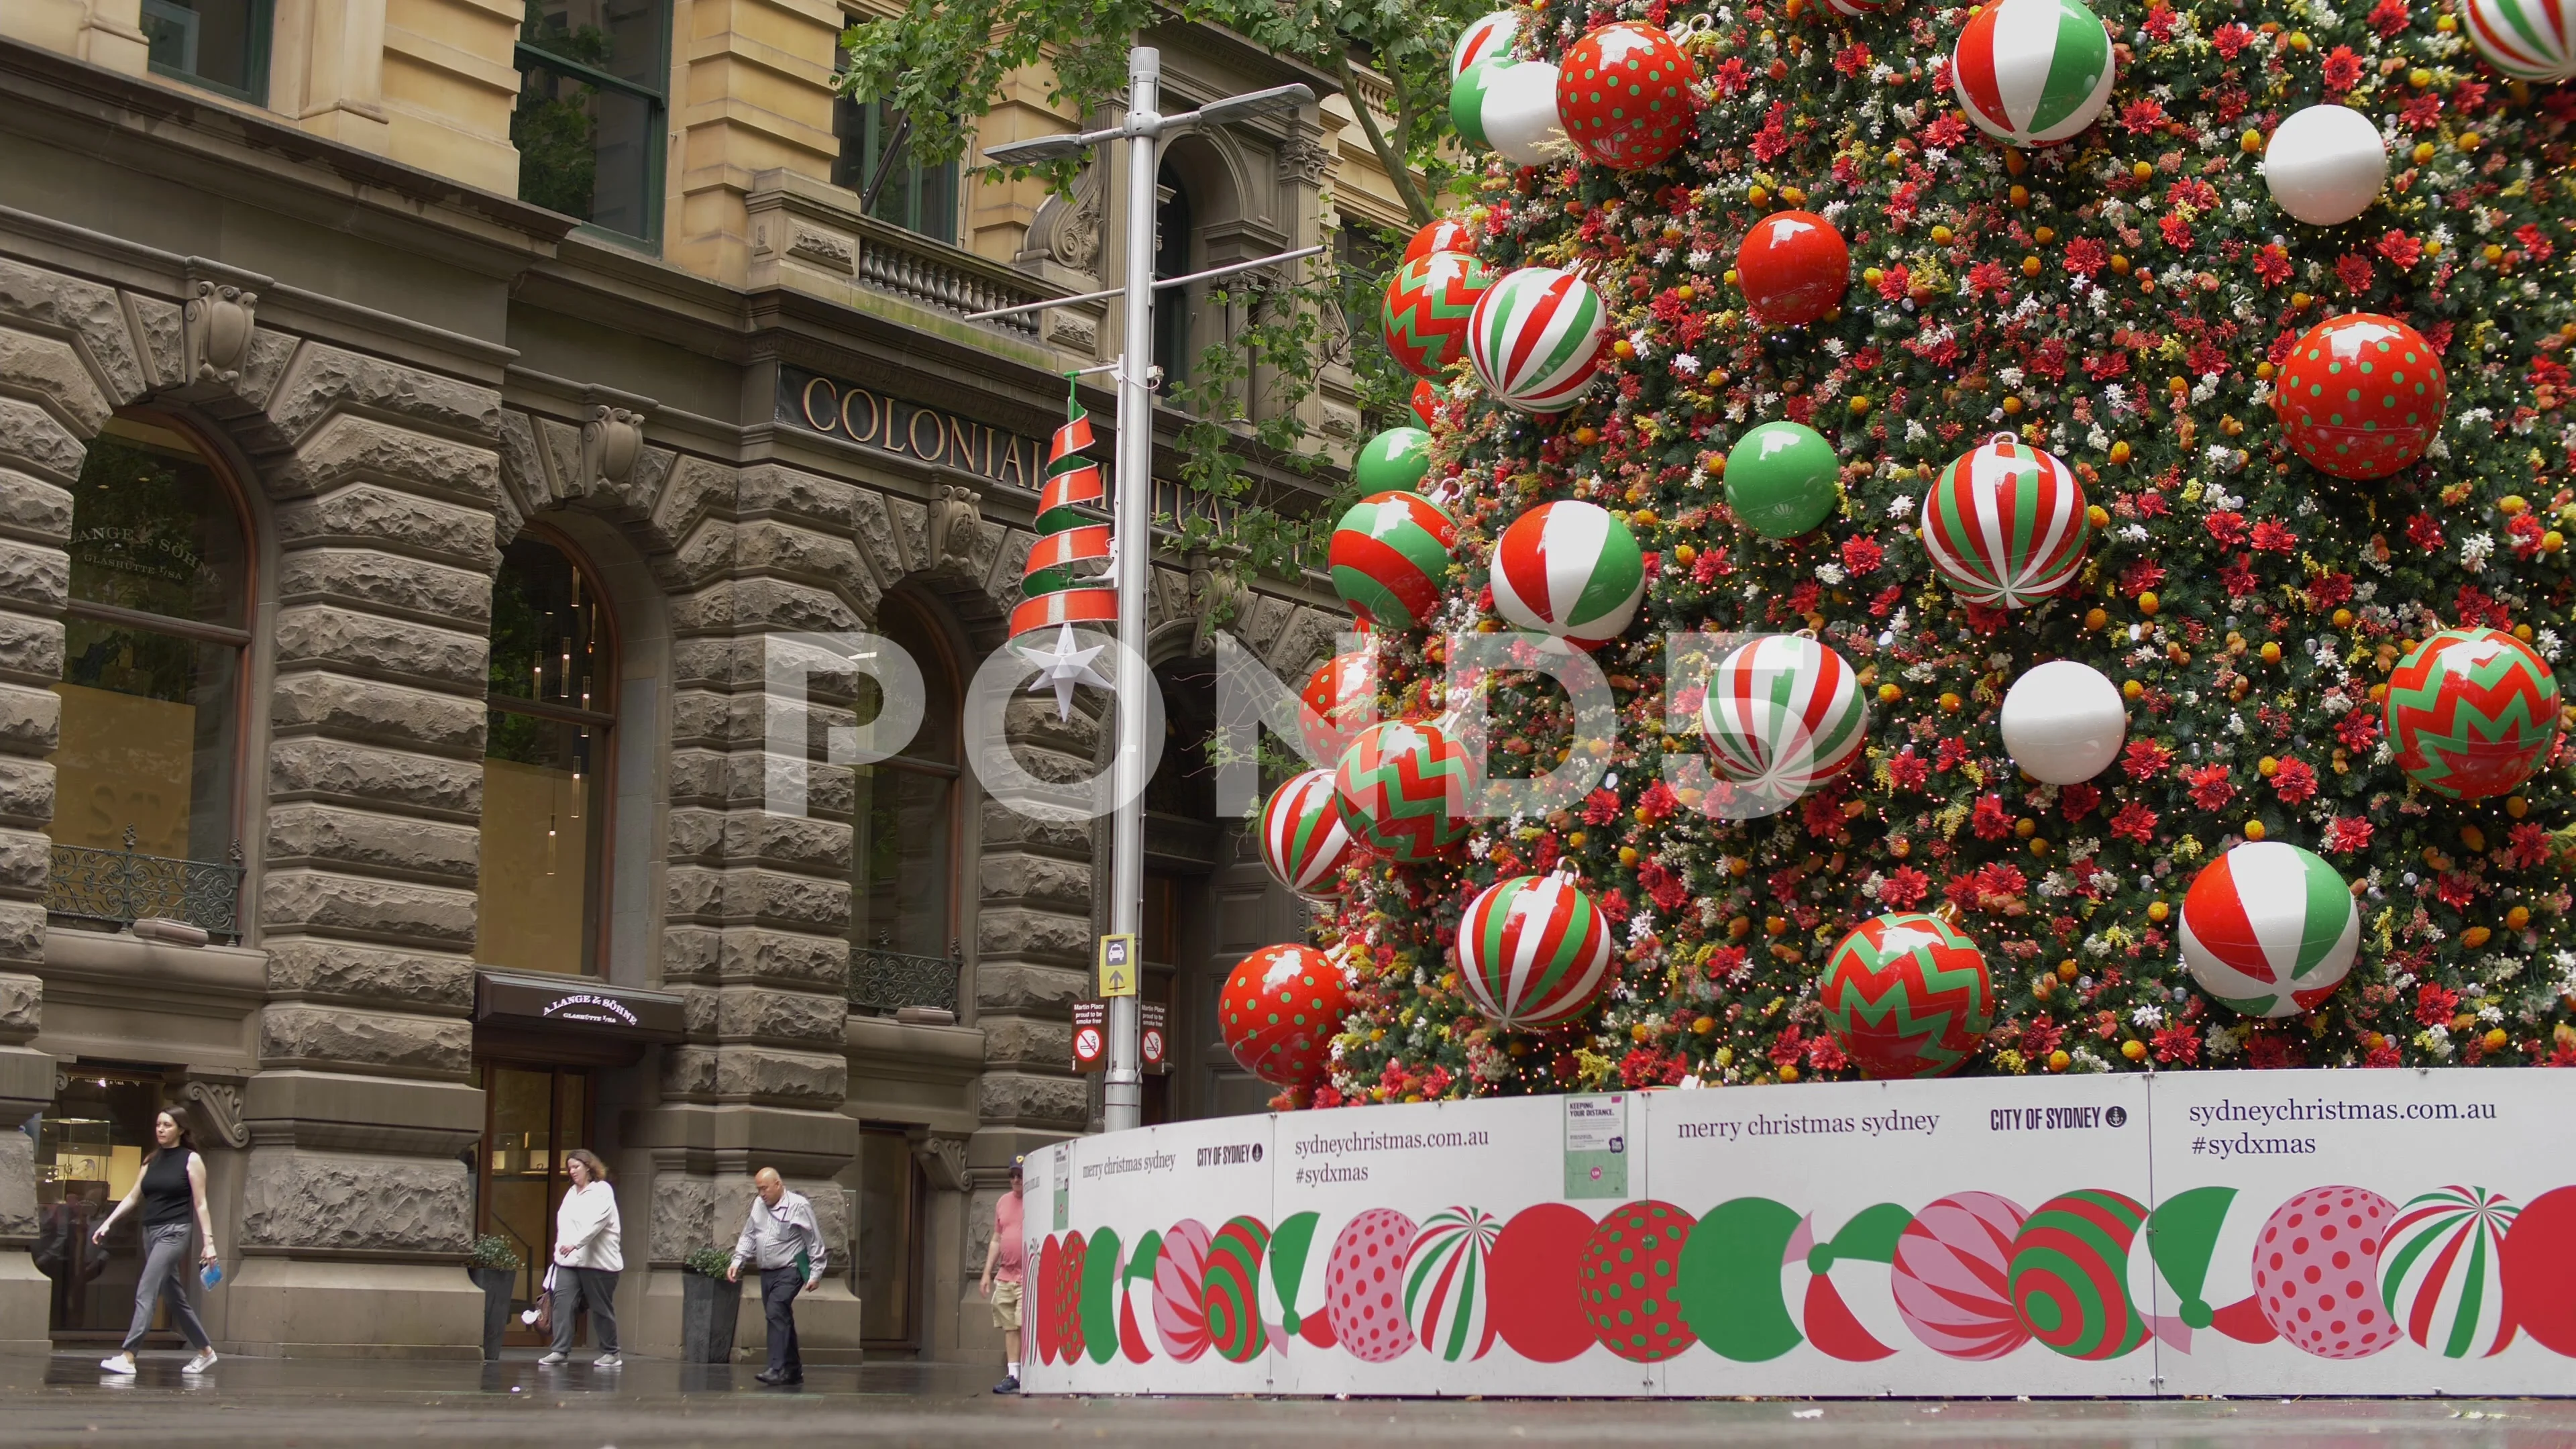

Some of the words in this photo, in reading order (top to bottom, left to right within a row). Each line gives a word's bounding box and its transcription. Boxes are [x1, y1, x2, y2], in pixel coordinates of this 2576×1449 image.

[84, 554, 155, 575] GLASHÜTTE
[159, 539, 221, 586] SÖHNE
[592, 996, 602, 1005] &
[602, 999, 637, 1026] SÖHNE
[1677, 1121, 1743, 1142] merry
[1748, 1114, 1855, 1136] christmas
[1862, 1110, 1941, 1137] sydney
[1990, 1109, 2022, 1130] CITY
[2026, 1108, 2043, 1130] OF
[2046, 1106, 2101, 1129] SYDNEY
[2189, 1098, 2496, 1126] sydneychristmas.com.au
[1197, 1147, 1212, 1167] CITY
[1214, 1146, 1222, 1165] OF
[1222, 1144, 1250, 1164] SYDNEY
[1295, 1130, 1489, 1159] sydneychristmas.com.au
[2192, 1132, 2316, 1159] #sydxmas
[1083, 1163, 1104, 1180] merry
[1104, 1155, 1142, 1175] christmas
[1143, 1150, 1176, 1174] sydney
[1295, 1163, 1368, 1188] #sydxmas
